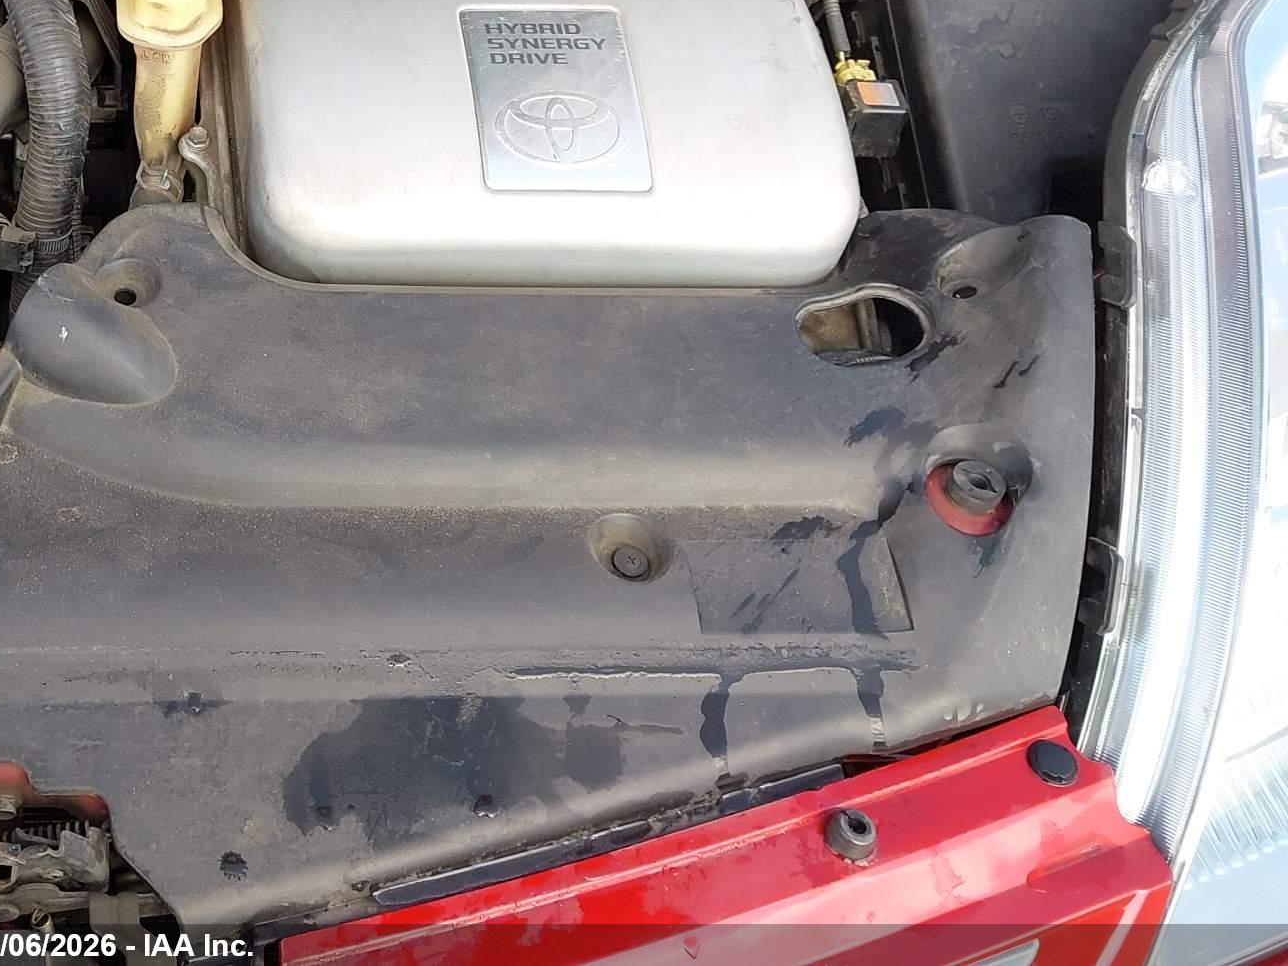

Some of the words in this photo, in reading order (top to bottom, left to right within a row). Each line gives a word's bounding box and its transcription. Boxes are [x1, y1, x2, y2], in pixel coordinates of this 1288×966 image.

[485, 23, 581, 34] HYBRID
[487, 38, 606, 50] SYNERGY
[142, 49, 171, 64] LOW
[490, 53, 568, 64] DRIVE
